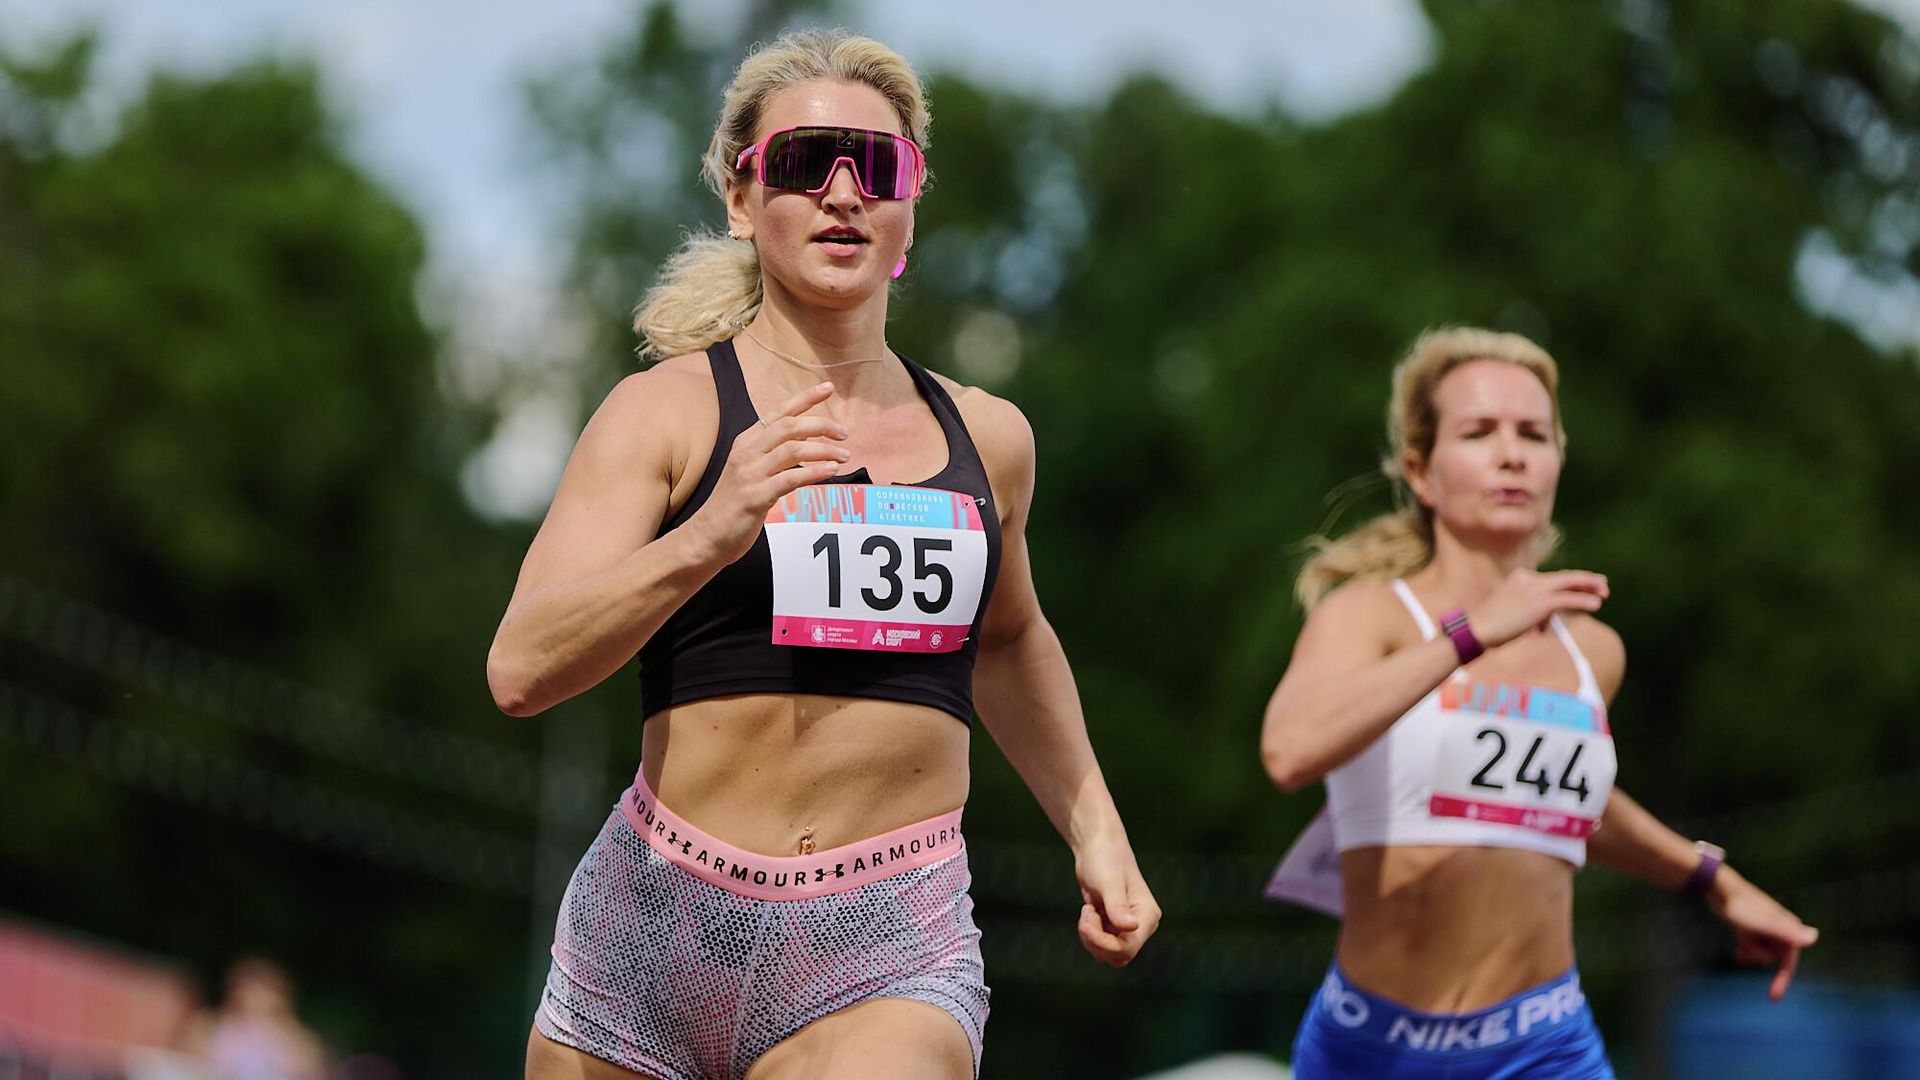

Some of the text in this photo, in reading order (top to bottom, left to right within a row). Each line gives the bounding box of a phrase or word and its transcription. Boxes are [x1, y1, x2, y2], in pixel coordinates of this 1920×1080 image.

[876, 491, 944, 503] СОРЕВНОВАНИЯ
[879, 512, 925, 523] АТЛЕТИКЕ
[813, 533, 953, 614] 135
[1471, 729, 1589, 803] 244
[696, 830, 948, 887] ARMOUR ARMOUR
[1388, 1009, 1511, 1050] NIKE
